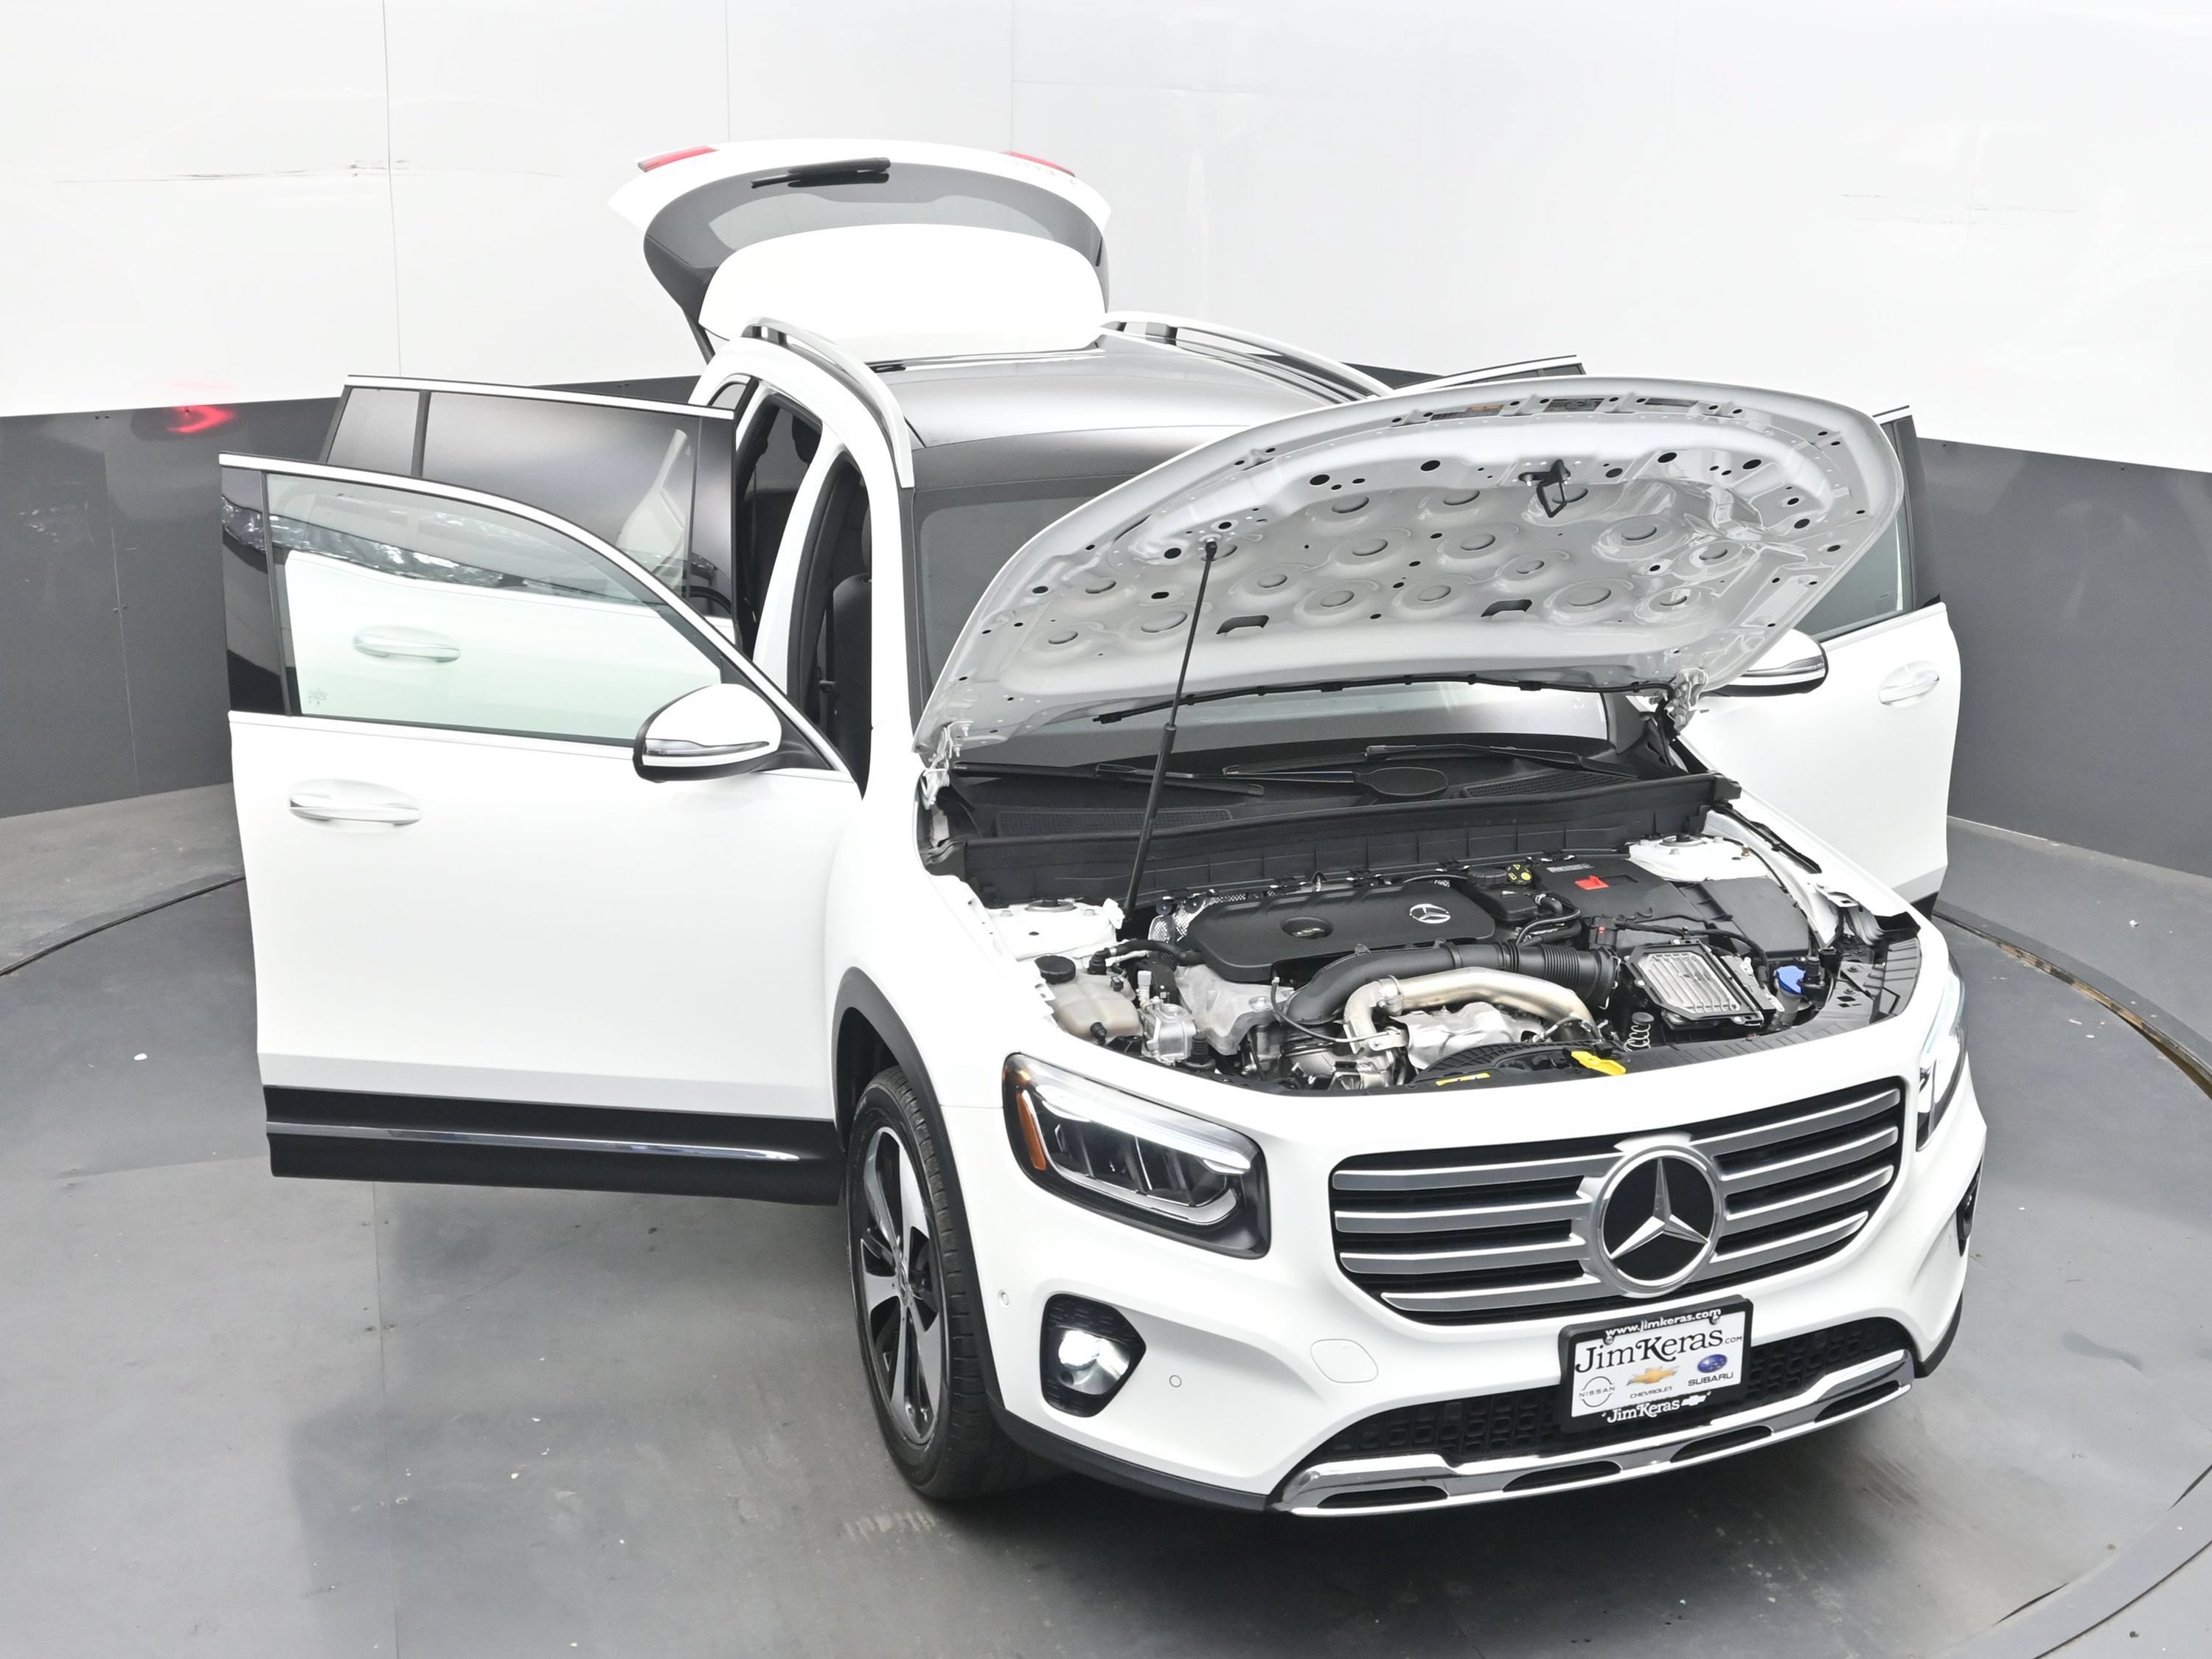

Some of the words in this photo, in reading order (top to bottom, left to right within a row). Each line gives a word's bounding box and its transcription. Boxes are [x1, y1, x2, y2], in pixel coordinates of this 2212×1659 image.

[1605, 1309, 1721, 1336] www.jimkeras.com
[1688, 1372, 1734, 1386] SUBARU
[1579, 1386, 1615, 1398] NISSAN
[1630, 1386, 1673, 1398] CHEVROLET
